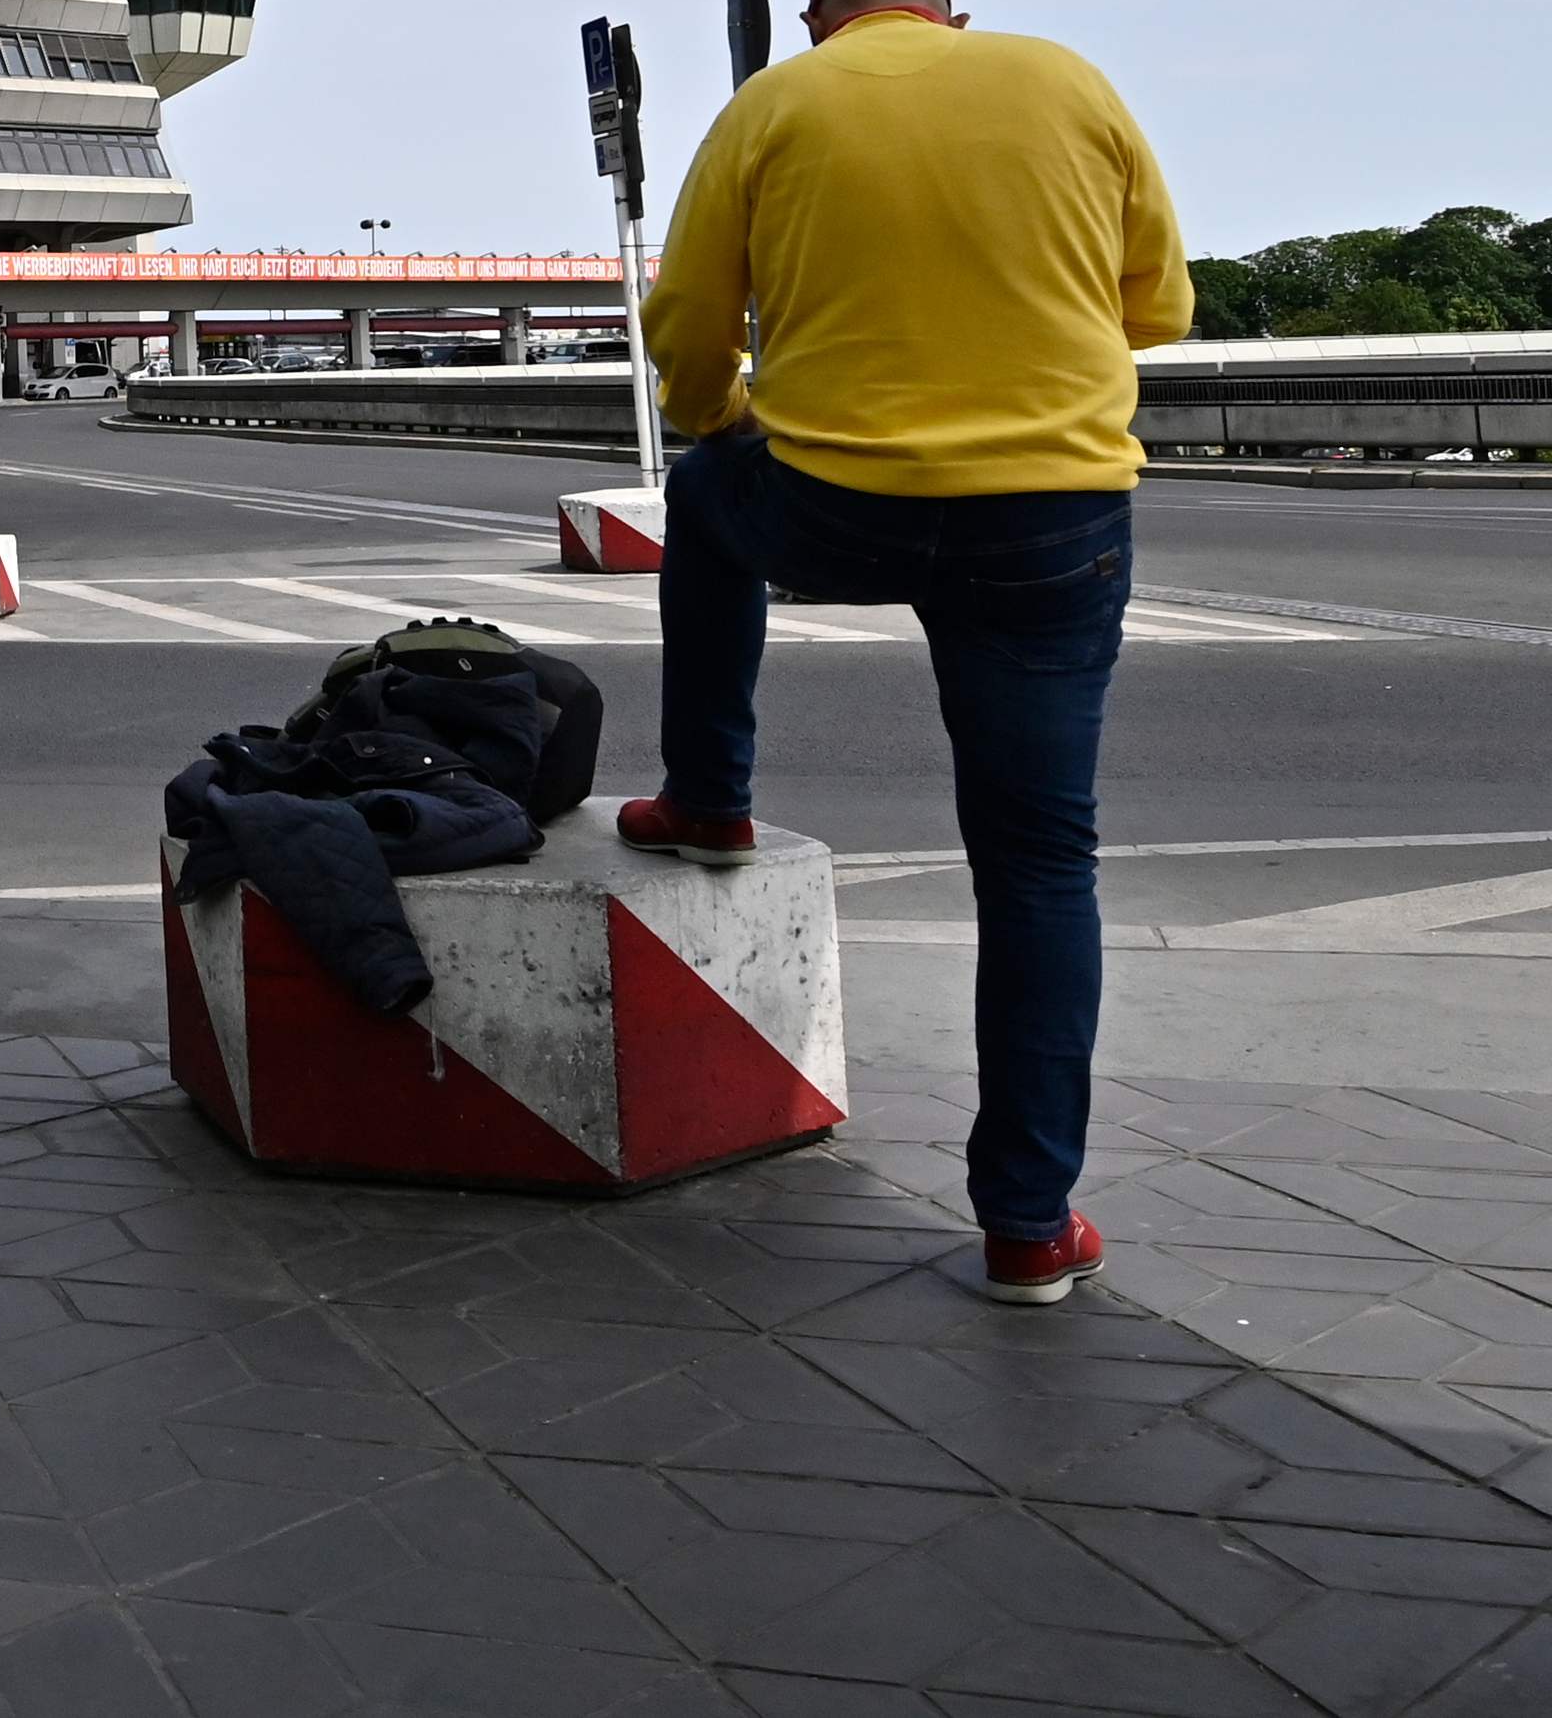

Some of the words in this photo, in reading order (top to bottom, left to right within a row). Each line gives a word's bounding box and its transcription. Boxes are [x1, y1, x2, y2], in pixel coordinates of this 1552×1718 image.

[12, 256, 119, 277] WERBEBOTSCHAFT
[121, 257, 137, 276] ZU
[179, 258, 198, 276] IHR
[201, 258, 228, 276] HABT
[231, 258, 258, 276] EUCH
[260, 258, 288, 277] JETZT
[290, 259, 316, 277] ECHT
[317, 259, 356, 277] URLAUB
